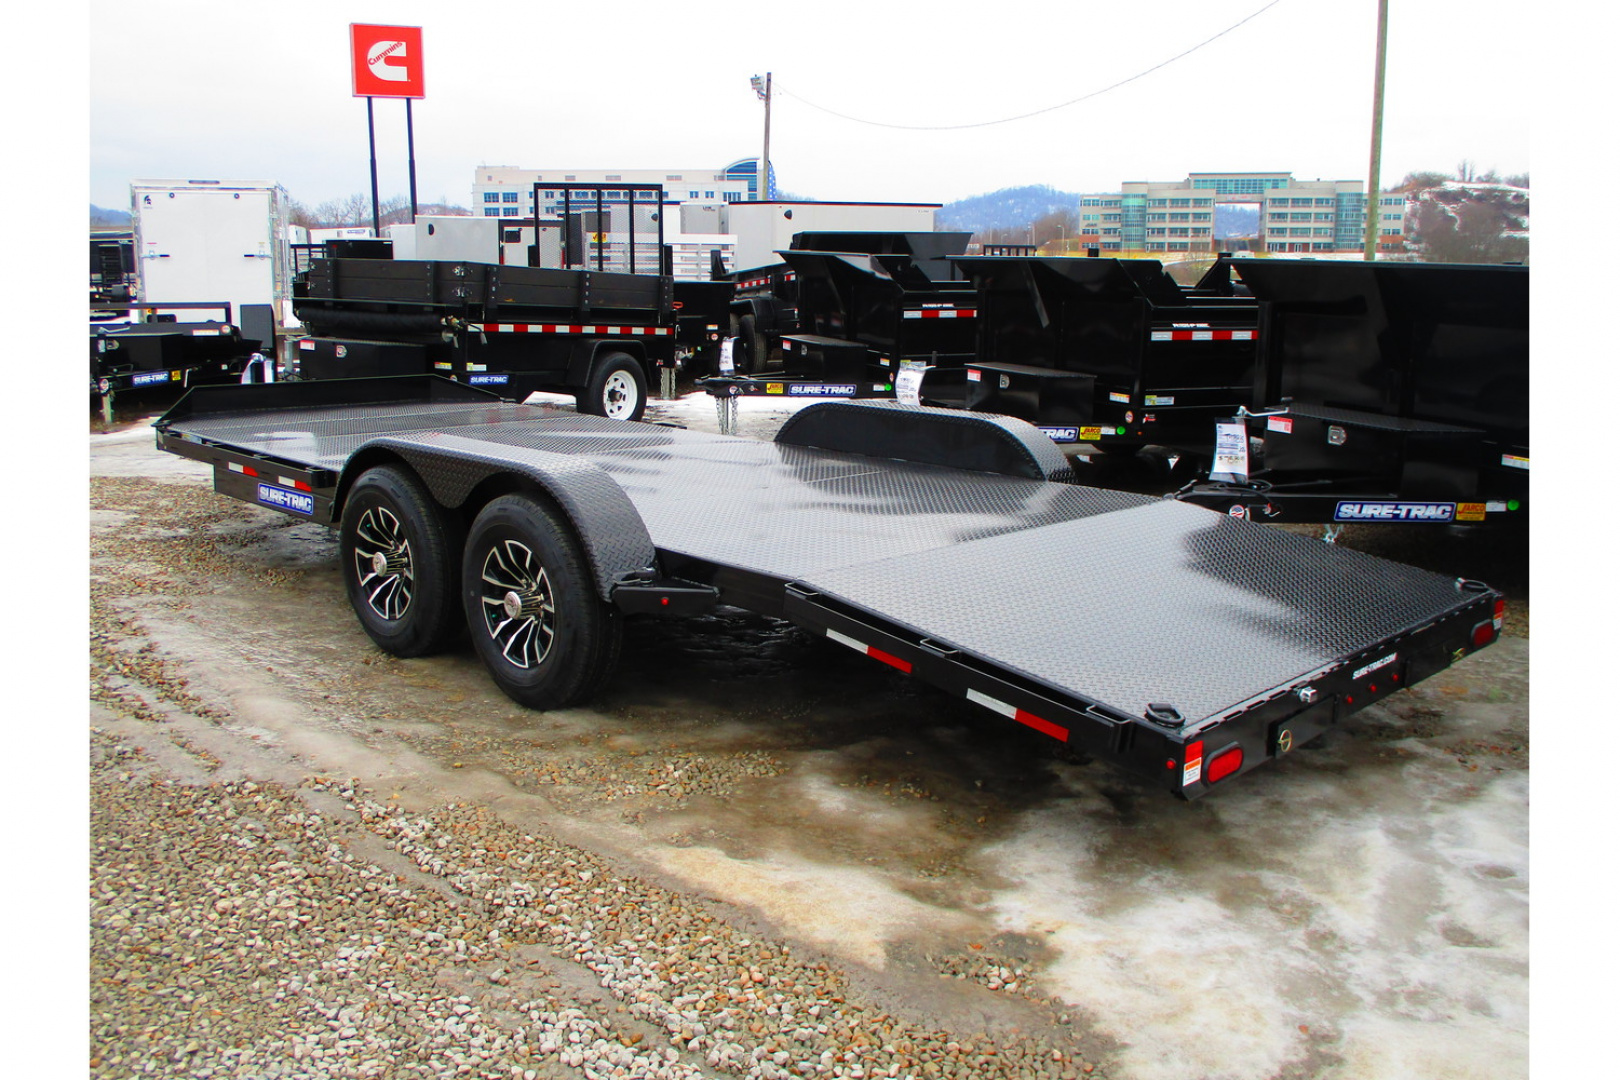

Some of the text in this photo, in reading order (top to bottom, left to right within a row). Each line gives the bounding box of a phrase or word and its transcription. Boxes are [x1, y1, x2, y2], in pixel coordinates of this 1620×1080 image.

[368, 42, 403, 65] Cummins
[791, 386, 854, 394] SURE-TRAC
[259, 486, 312, 512] SURE-TRAC
[1338, 504, 1452, 519] SURE-TRAC
